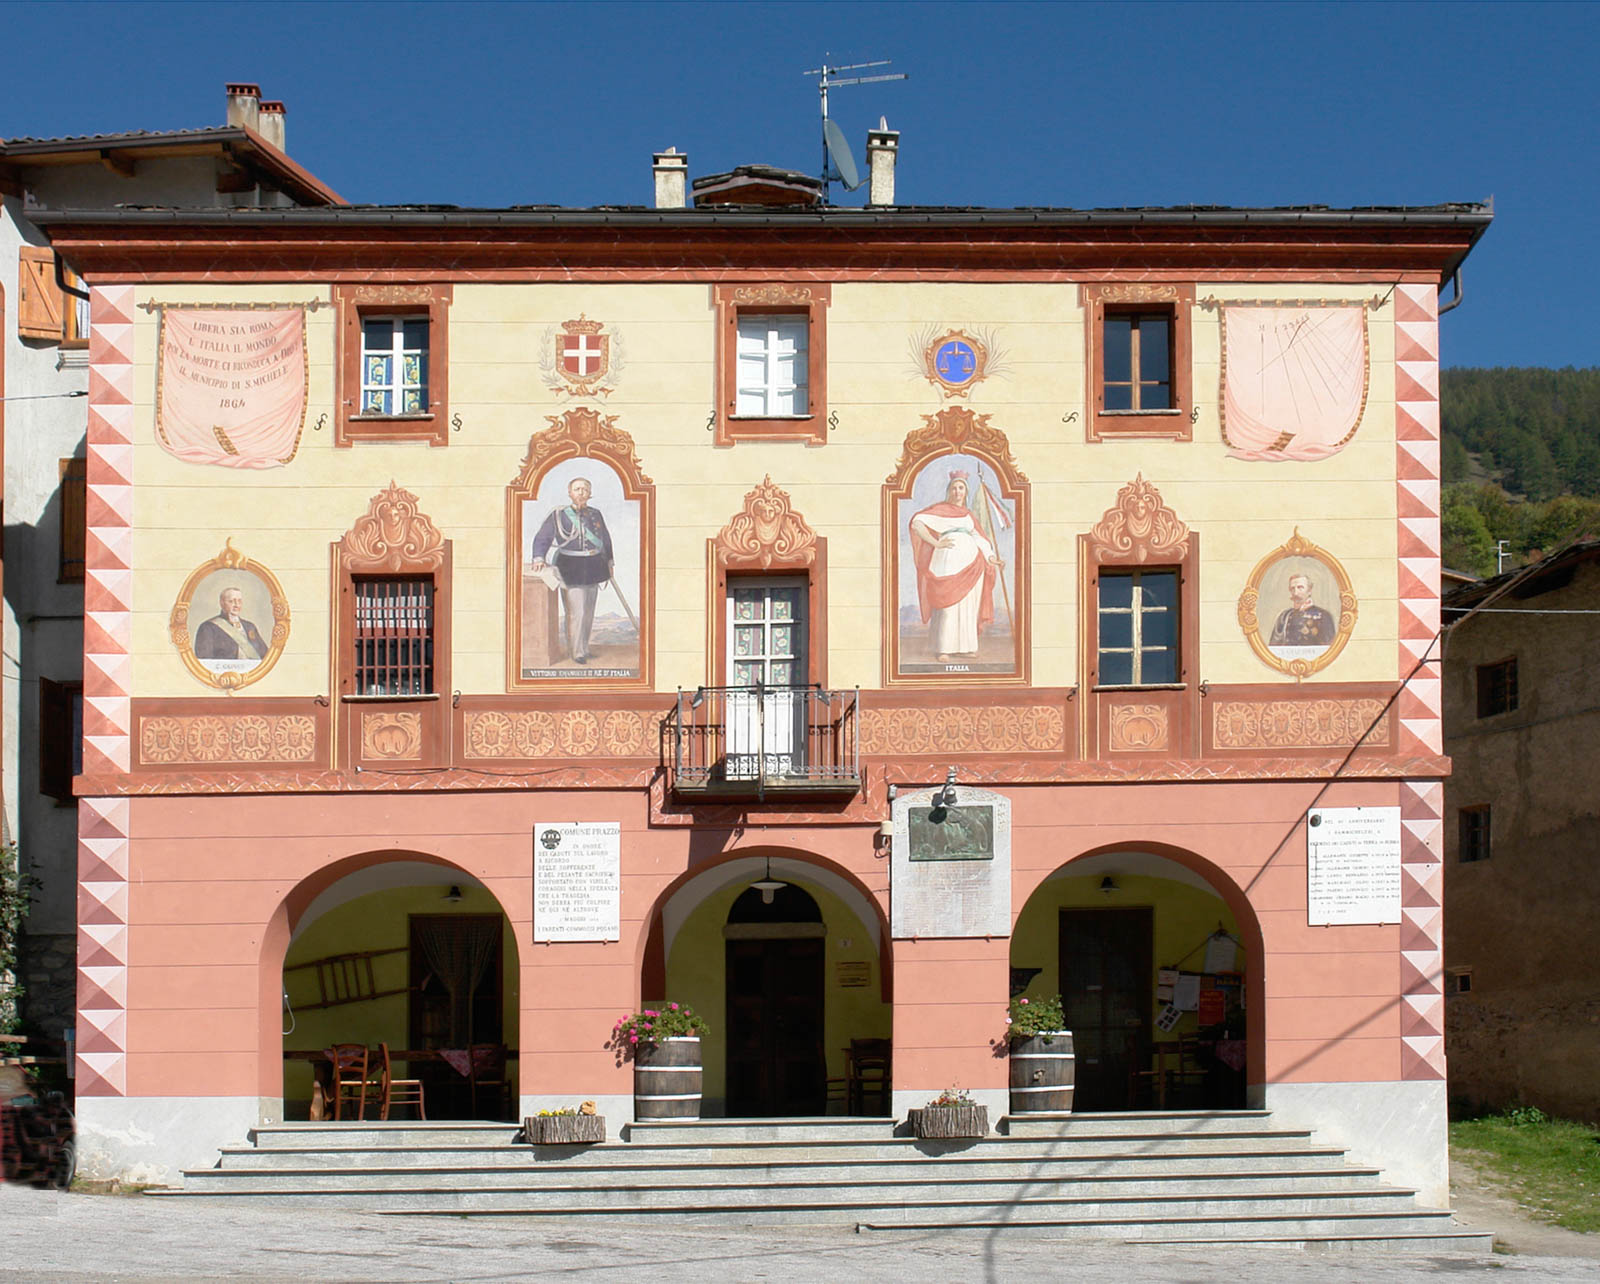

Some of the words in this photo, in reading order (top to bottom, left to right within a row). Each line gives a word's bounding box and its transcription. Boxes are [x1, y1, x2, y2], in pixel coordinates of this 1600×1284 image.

[192, 322, 226, 335] LIBERA
[229, 326, 246, 335] SIA
[249, 321, 277, 334] ROMA
[200, 340, 230, 353] ITALIA
[233, 343, 242, 353] IL
[246, 336, 277, 352] MONDO
[192, 354, 219, 370] MORTE
[222, 361, 231, 371] CI
[272, 354, 279, 363] A
[190, 370, 229, 389] MUNICIPIO
[231, 380, 240, 390] DI
[219, 399, 246, 408] 1864
[560, 828, 591, 836] COMUNE
[592, 827, 620, 836] PRAZZO
